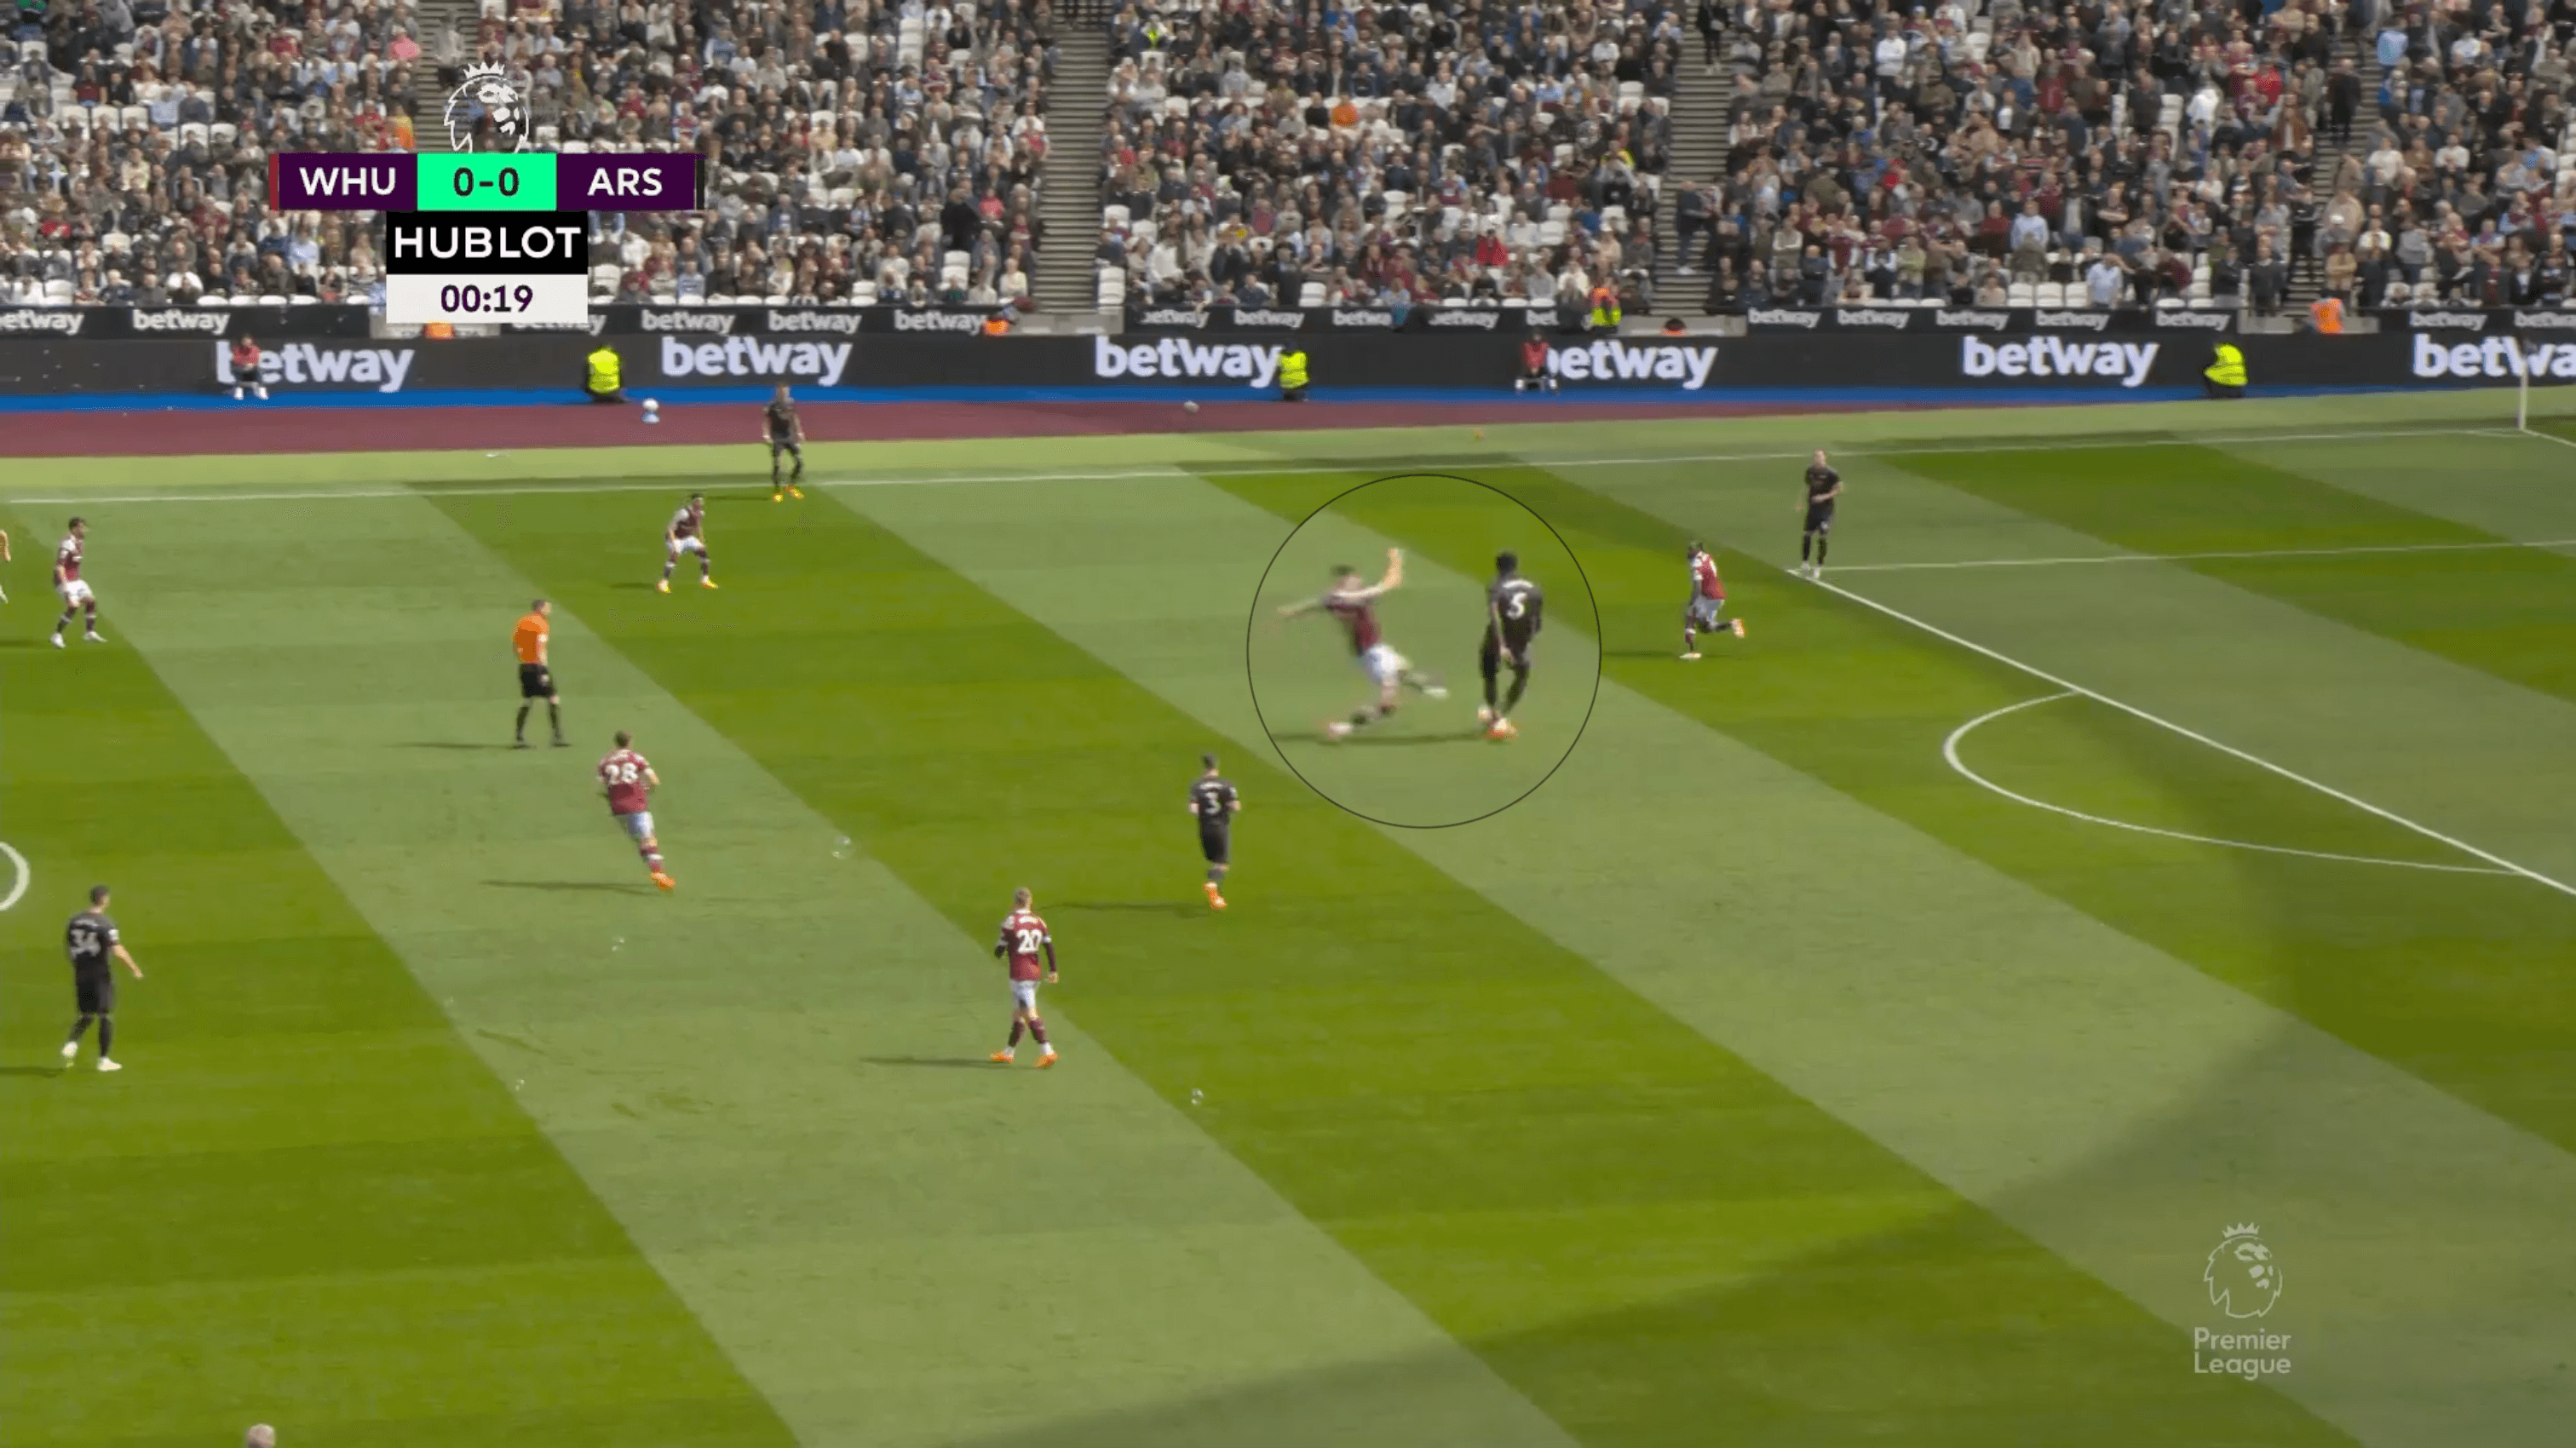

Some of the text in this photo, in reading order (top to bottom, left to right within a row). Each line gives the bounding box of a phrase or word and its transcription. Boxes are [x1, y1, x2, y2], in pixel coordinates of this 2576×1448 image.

[133, 309, 230, 334] betway
[641, 309, 735, 335] betway
[768, 309, 861, 334] betway
[894, 309, 987, 336] betway
[1234, 308, 1305, 329] betway
[1332, 309, 1392, 327] betwa
[1748, 307, 1822, 329] betway
[1837, 307, 1911, 329] betway
[1936, 309, 2010, 330] betway
[2035, 310, 2110, 331] betway
[2155, 310, 2231, 331] betway
[2409, 312, 2488, 331] betway
[2514, 311, 2576, 329] betwa
[661, 336, 853, 387] betway
[1095, 335, 1283, 388] betway
[1963, 336, 2159, 388] betway
[2412, 333, 2576, 377] betwa
[1506, 592, 1527, 620] 5
[1016, 929, 1043, 953] 20
